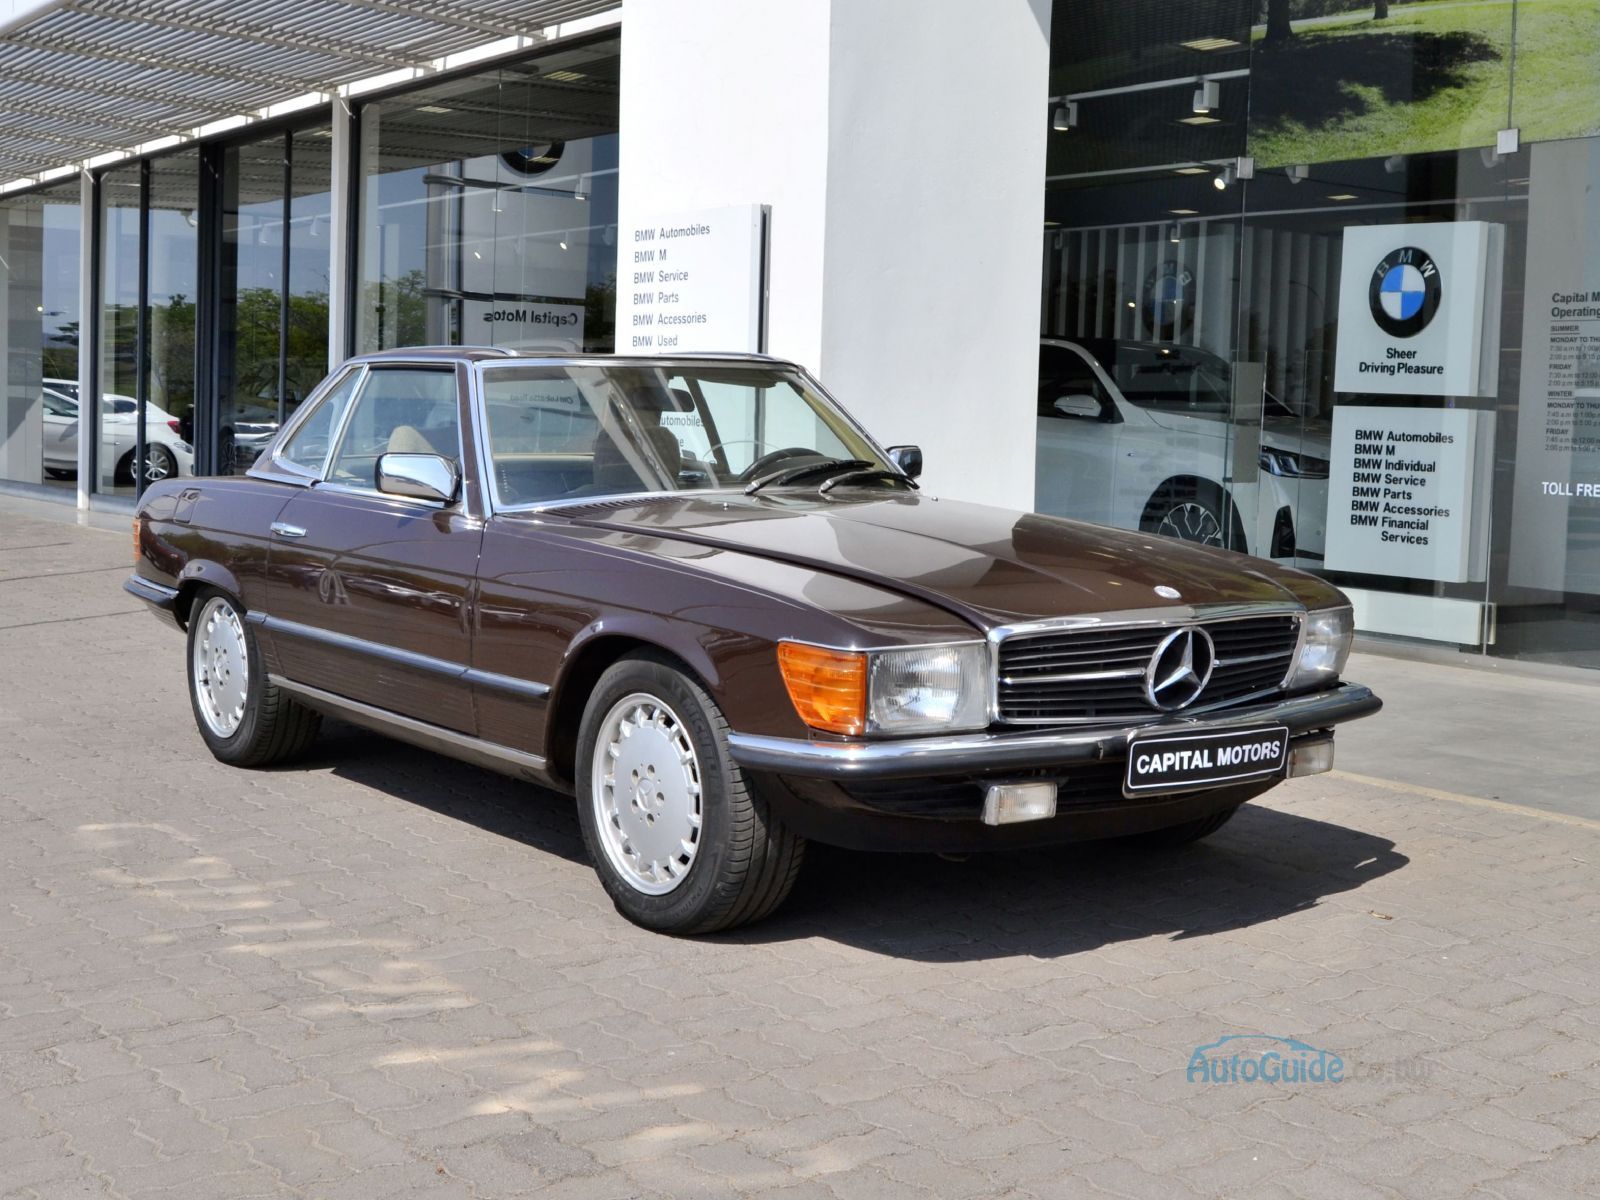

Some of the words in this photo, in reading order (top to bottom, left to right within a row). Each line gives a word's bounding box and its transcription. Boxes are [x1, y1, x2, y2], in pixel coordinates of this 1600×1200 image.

[634, 228, 656, 242] BMW
[659, 223, 711, 240] Automobiles
[634, 250, 655, 263] BMW
[659, 249, 667, 261] M
[1377, 249, 1436, 278] BMW
[633, 271, 655, 284] BMW
[658, 270, 689, 283] Service
[633, 292, 654, 305] BMW
[658, 291, 679, 304] Parts
[1552, 292, 1588, 305] Capital
[632, 313, 654, 326] BMW
[657, 312, 707, 325] Accessories
[632, 335, 653, 347] BMW
[657, 334, 678, 347] Used
[1386, 347, 1417, 359] Sheer
[1359, 361, 1395, 375] Driving
[1397, 362, 1444, 375] Pleasure
[1355, 429, 1384, 441] BMW
[1387, 431, 1454, 444] Automobiles
[1354, 443, 1383, 456] BMW
[1385, 444, 1395, 456] M
[1353, 457, 1382, 470] BMW
[1385, 459, 1436, 473] Individual
[1353, 472, 1382, 484] BMW
[1384, 473, 1426, 487] Service
[1352, 486, 1381, 498] BMW
[1383, 488, 1412, 500] Parts
[1541, 481, 1574, 496] TOLL
[1576, 483, 1600, 498] FRE
[1351, 500, 1380, 512] BMW
[1383, 502, 1450, 517] Accessories
[1350, 514, 1379, 527] BMW
[1381, 516, 1429, 531] Financial
[1381, 530, 1429, 545] Services
[1136, 749, 1213, 774] CAPITAL
[1217, 740, 1281, 767] MOTORS
